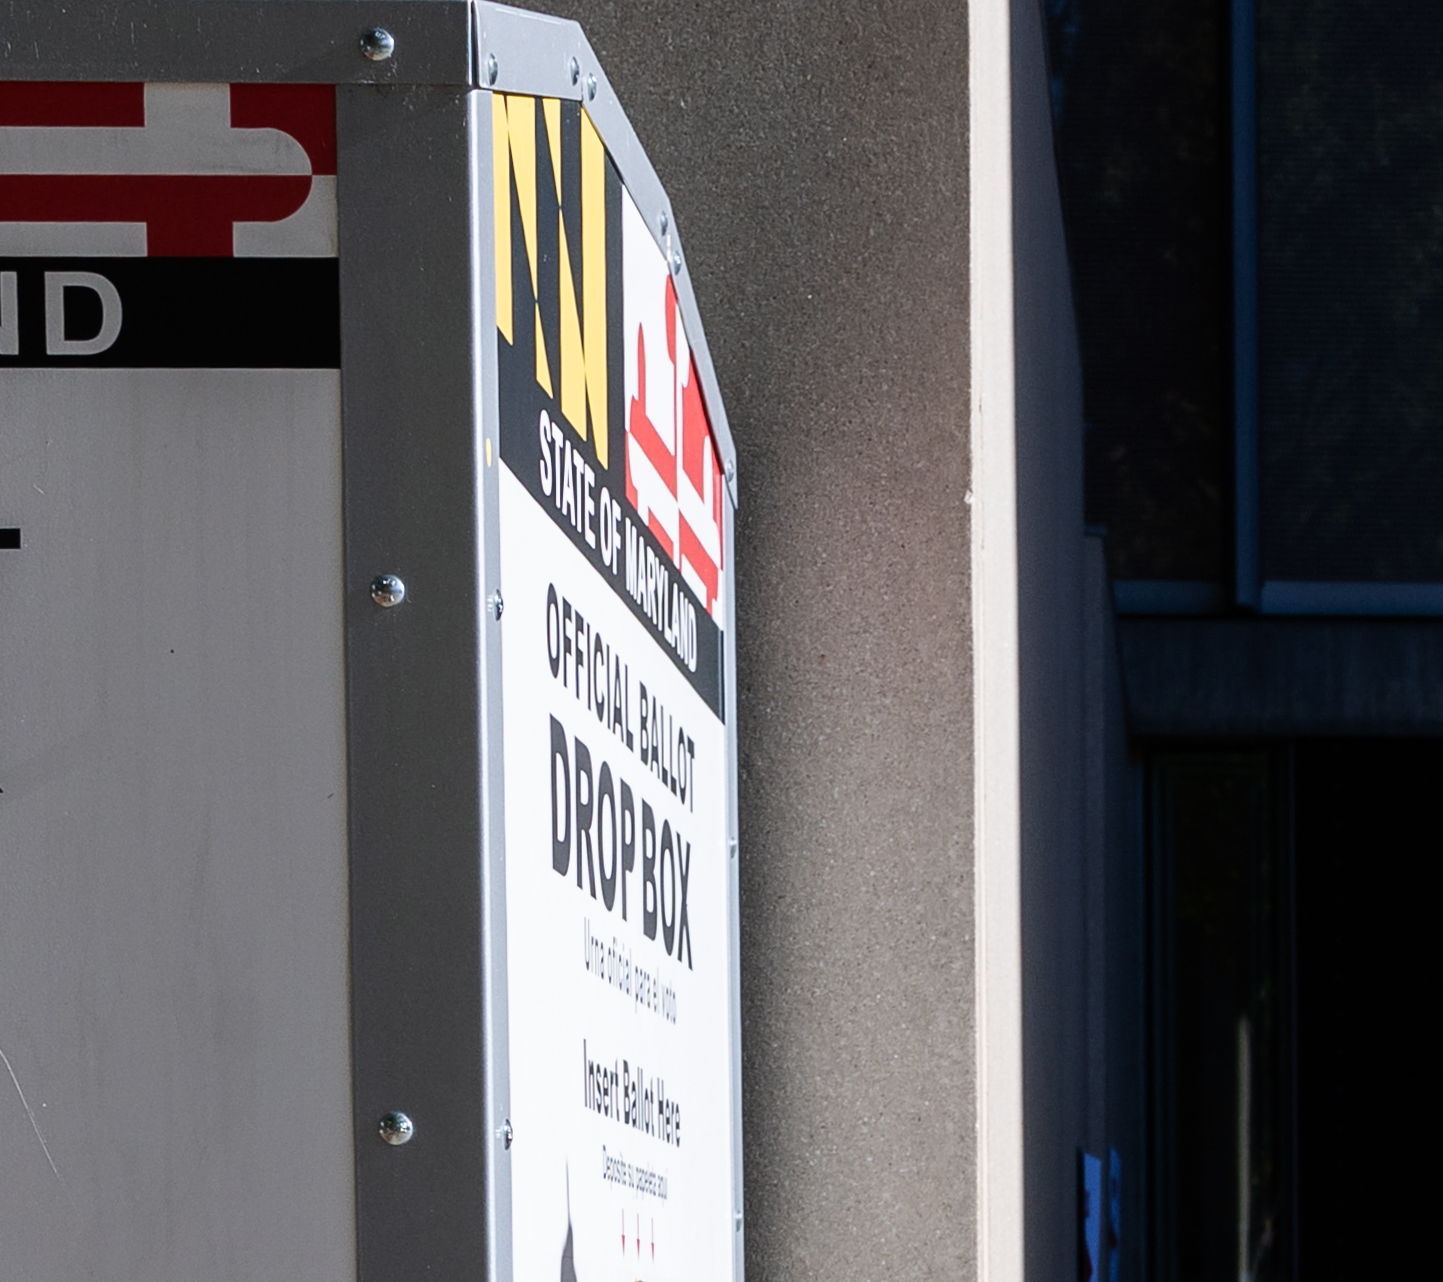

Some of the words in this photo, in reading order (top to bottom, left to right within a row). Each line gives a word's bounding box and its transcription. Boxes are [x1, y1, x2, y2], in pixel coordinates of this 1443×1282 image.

[539, 409, 596, 549] STATE
[600, 486, 621, 576] OF
[625, 516, 698, 673] MARYLAND
[546, 582, 634, 753] OFFICIAL
[639, 680, 695, 814] BALLOT
[549, 712, 637, 923] DROP
[642, 797, 694, 972] BOX
[583, 916, 604, 980] Urna
[607, 935, 632, 998] oficial
[634, 964, 651, 1014] para
[661, 980, 677, 1025] voto
[583, 1038, 620, 1122] Insert
[623, 1059, 655, 1137] Ballot
[657, 1076, 681, 1148] Here
